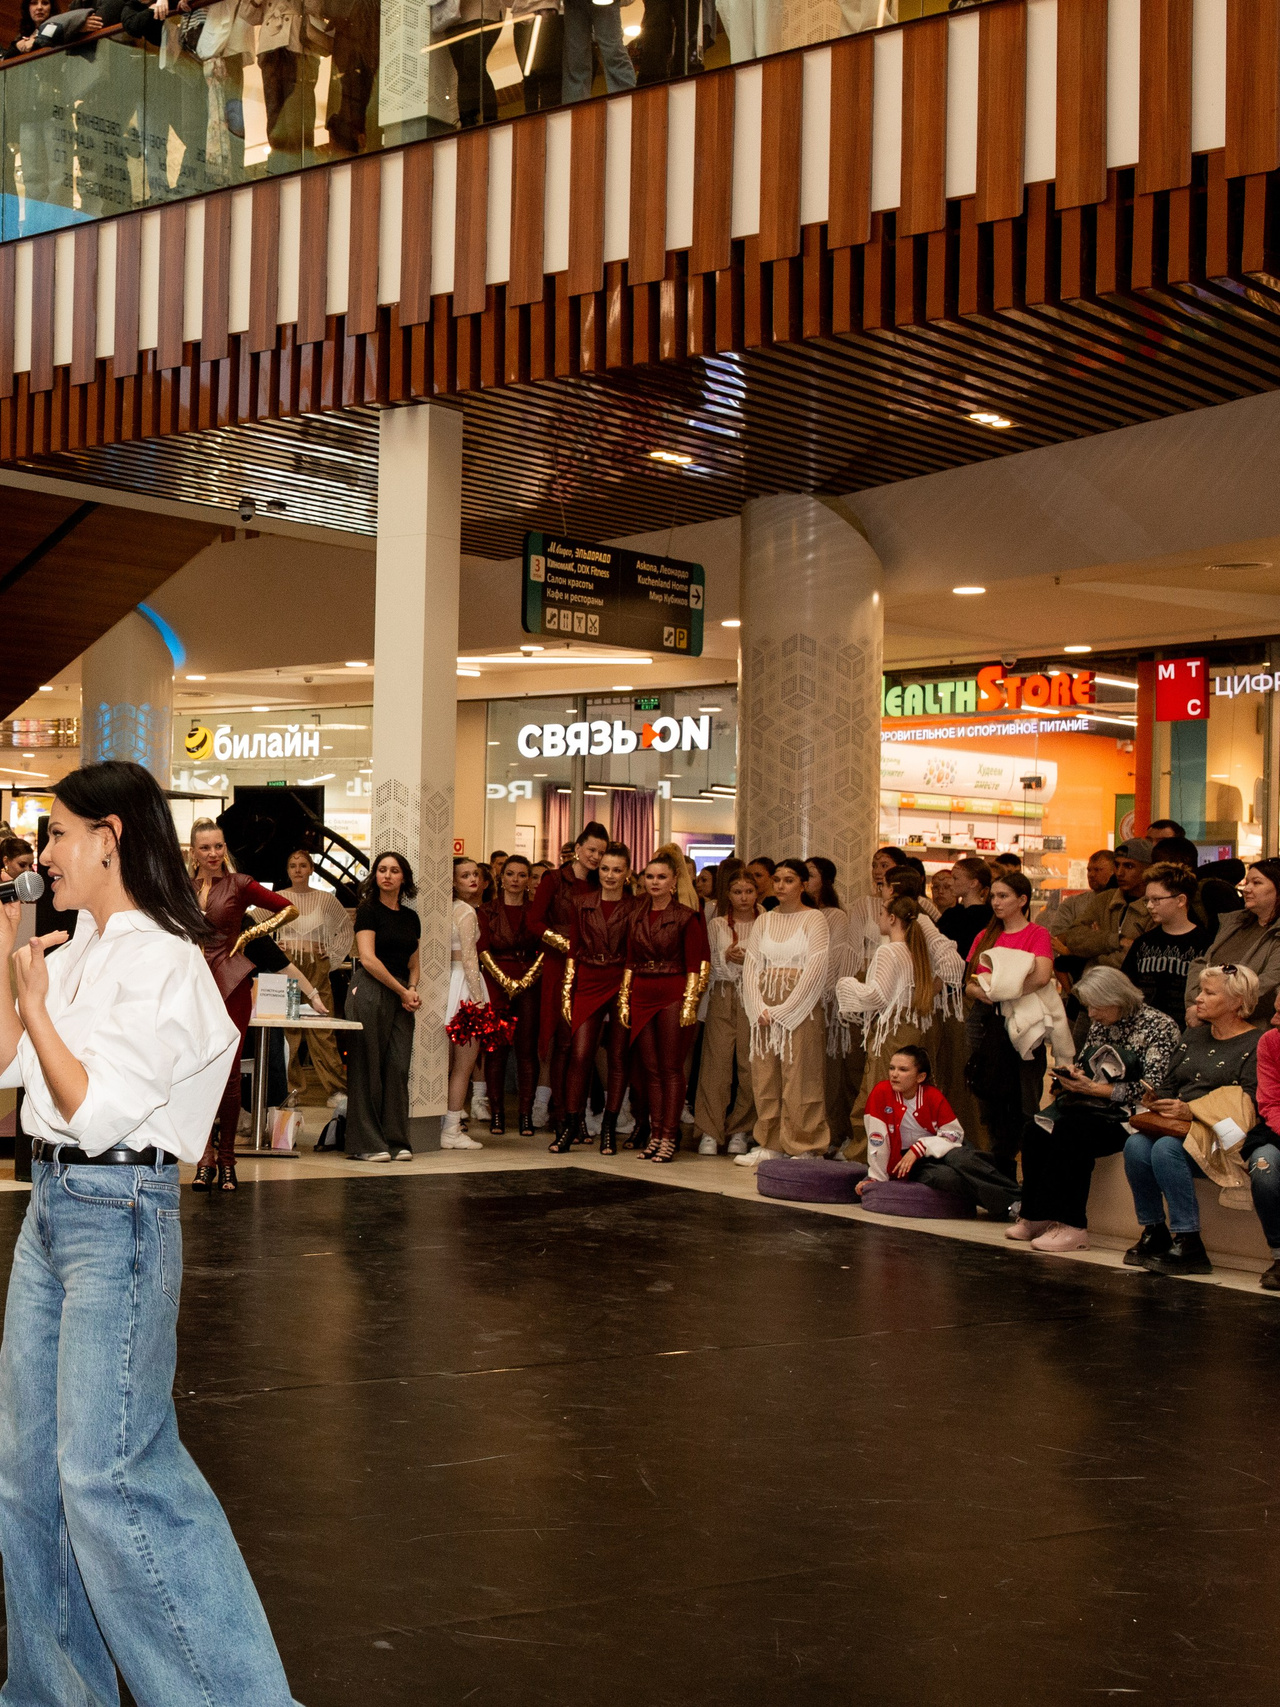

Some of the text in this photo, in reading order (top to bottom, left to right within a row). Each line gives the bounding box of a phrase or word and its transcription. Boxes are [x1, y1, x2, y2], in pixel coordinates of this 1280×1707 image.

[535, 558, 541, 573] 3
[591, 565, 610, 579] Fitness
[660, 564, 689, 579] Леонардо
[547, 573, 567, 585] Салон
[568, 579, 594, 590] красоты
[637, 574, 688, 592] Kuchenland Home
[547, 587, 563, 600] Кафе
[570, 593, 604, 606] рестораны
[957, 727, 965, 737] И
[967, 722, 1038, 737] СПОРТИВНОЕ
[1039, 719, 1089, 733] ПИТАНИЕ
[214, 724, 320, 761] билайн
[517, 720, 637, 758] СВЯЗЬ
